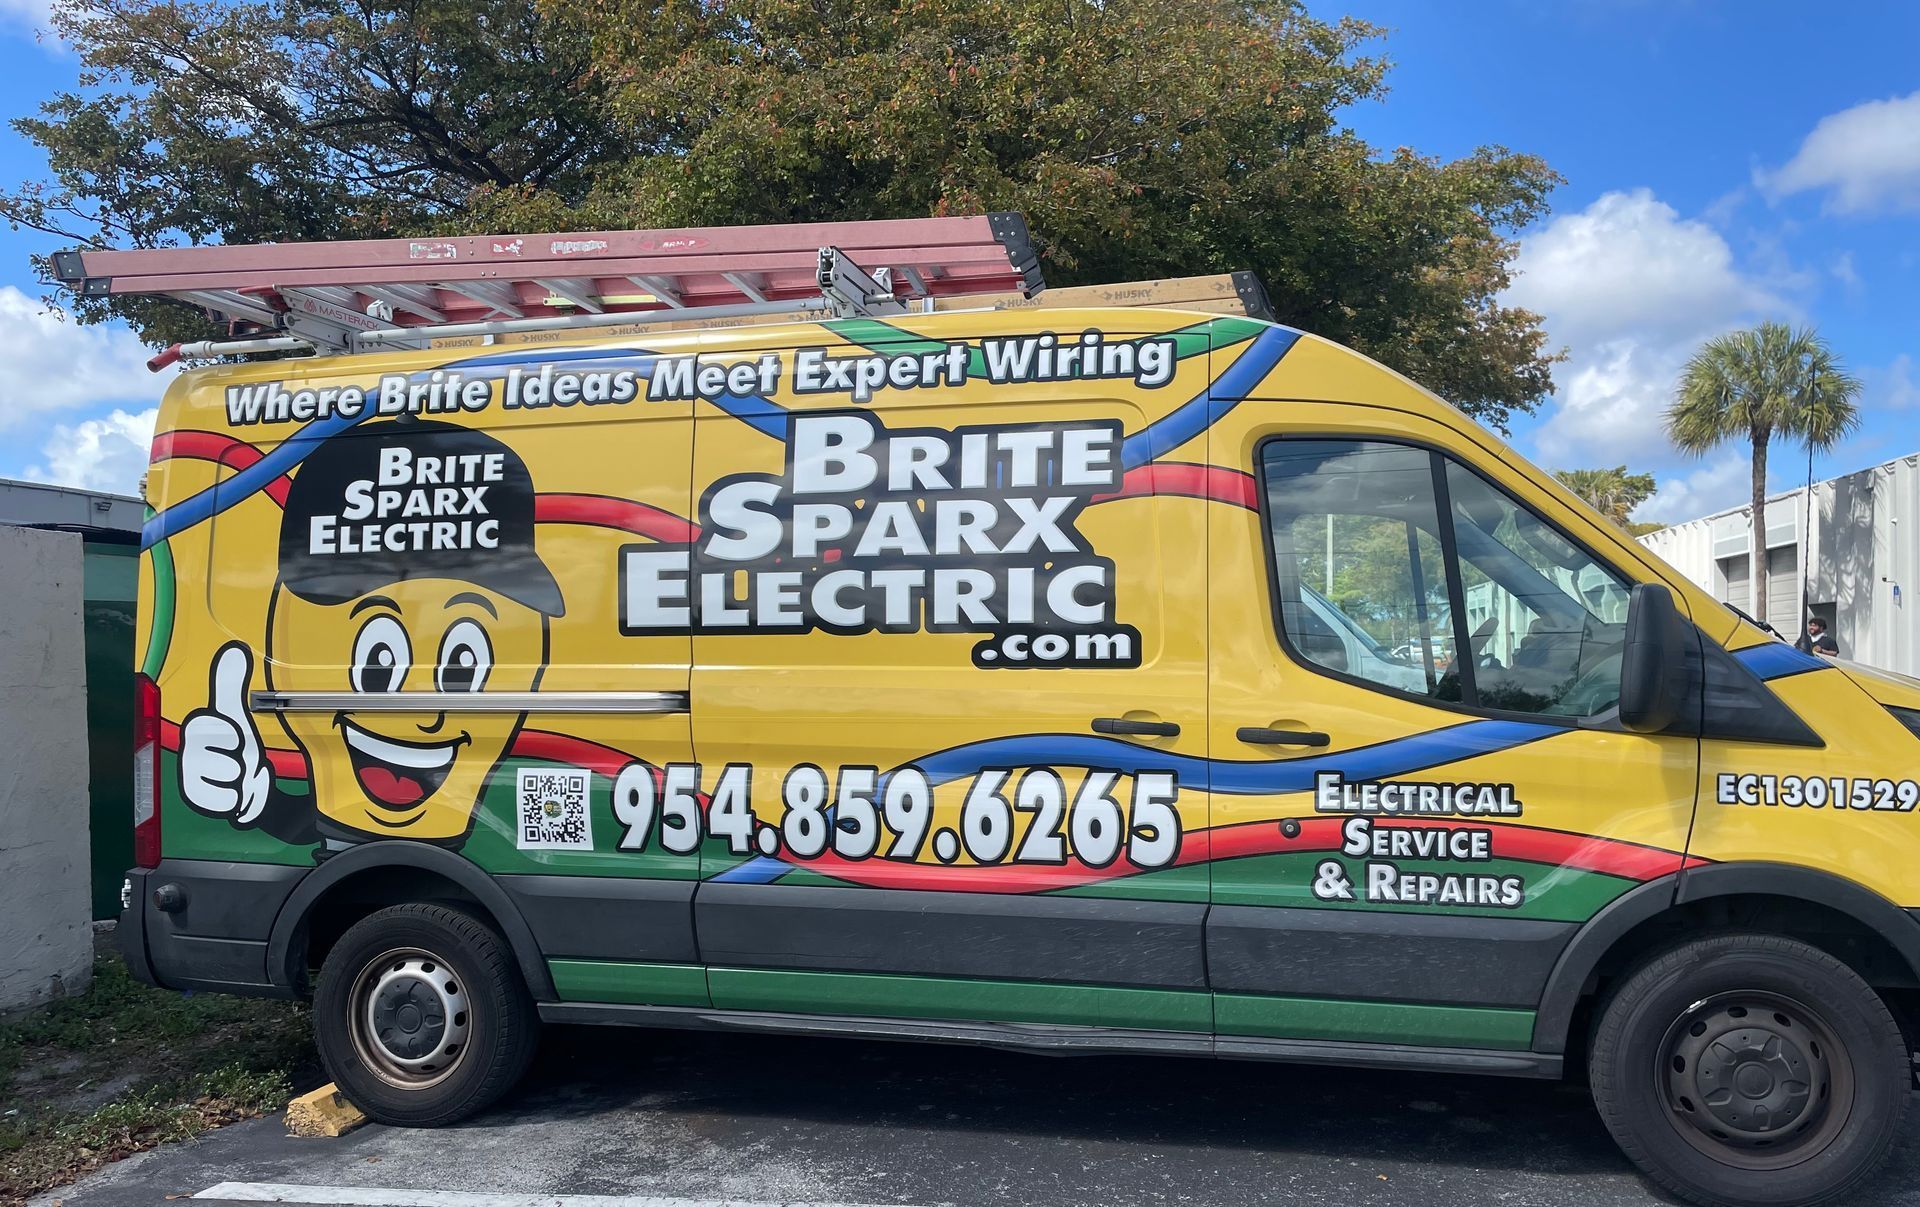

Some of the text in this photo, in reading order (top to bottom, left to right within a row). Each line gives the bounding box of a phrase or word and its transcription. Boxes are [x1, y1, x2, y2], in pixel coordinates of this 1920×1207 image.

[1007, 297, 1043, 307] HUSKY
[1114, 288, 1152, 300] HUSKY
[319, 305, 380, 330] MASTERACK
[618, 326, 650, 336] HUSKY
[444, 339, 474, 348] HUSKY
[530, 333, 561, 343] HUSKY
[227, 335, 1174, 423] Where Brite Ideas Meet Expert Wiring
[378, 447, 505, 487] BRITE
[792, 415, 1115, 494] BRITE
[342, 479, 490, 521] SPARX
[309, 519, 499, 555] ELECTRIC
[703, 481, 1081, 562] SPARX
[626, 551, 1107, 628] ELECTRIC
[979, 632, 1133, 662] .com
[1318, 774, 1519, 814] ELECTRICAL
[1718, 774, 1919, 811] EC1301529
[613, 764, 1181, 866] 954.859.6265
[1344, 818, 1488, 859] SERVICE
[1314, 861, 1521, 906] & REPAIRS
